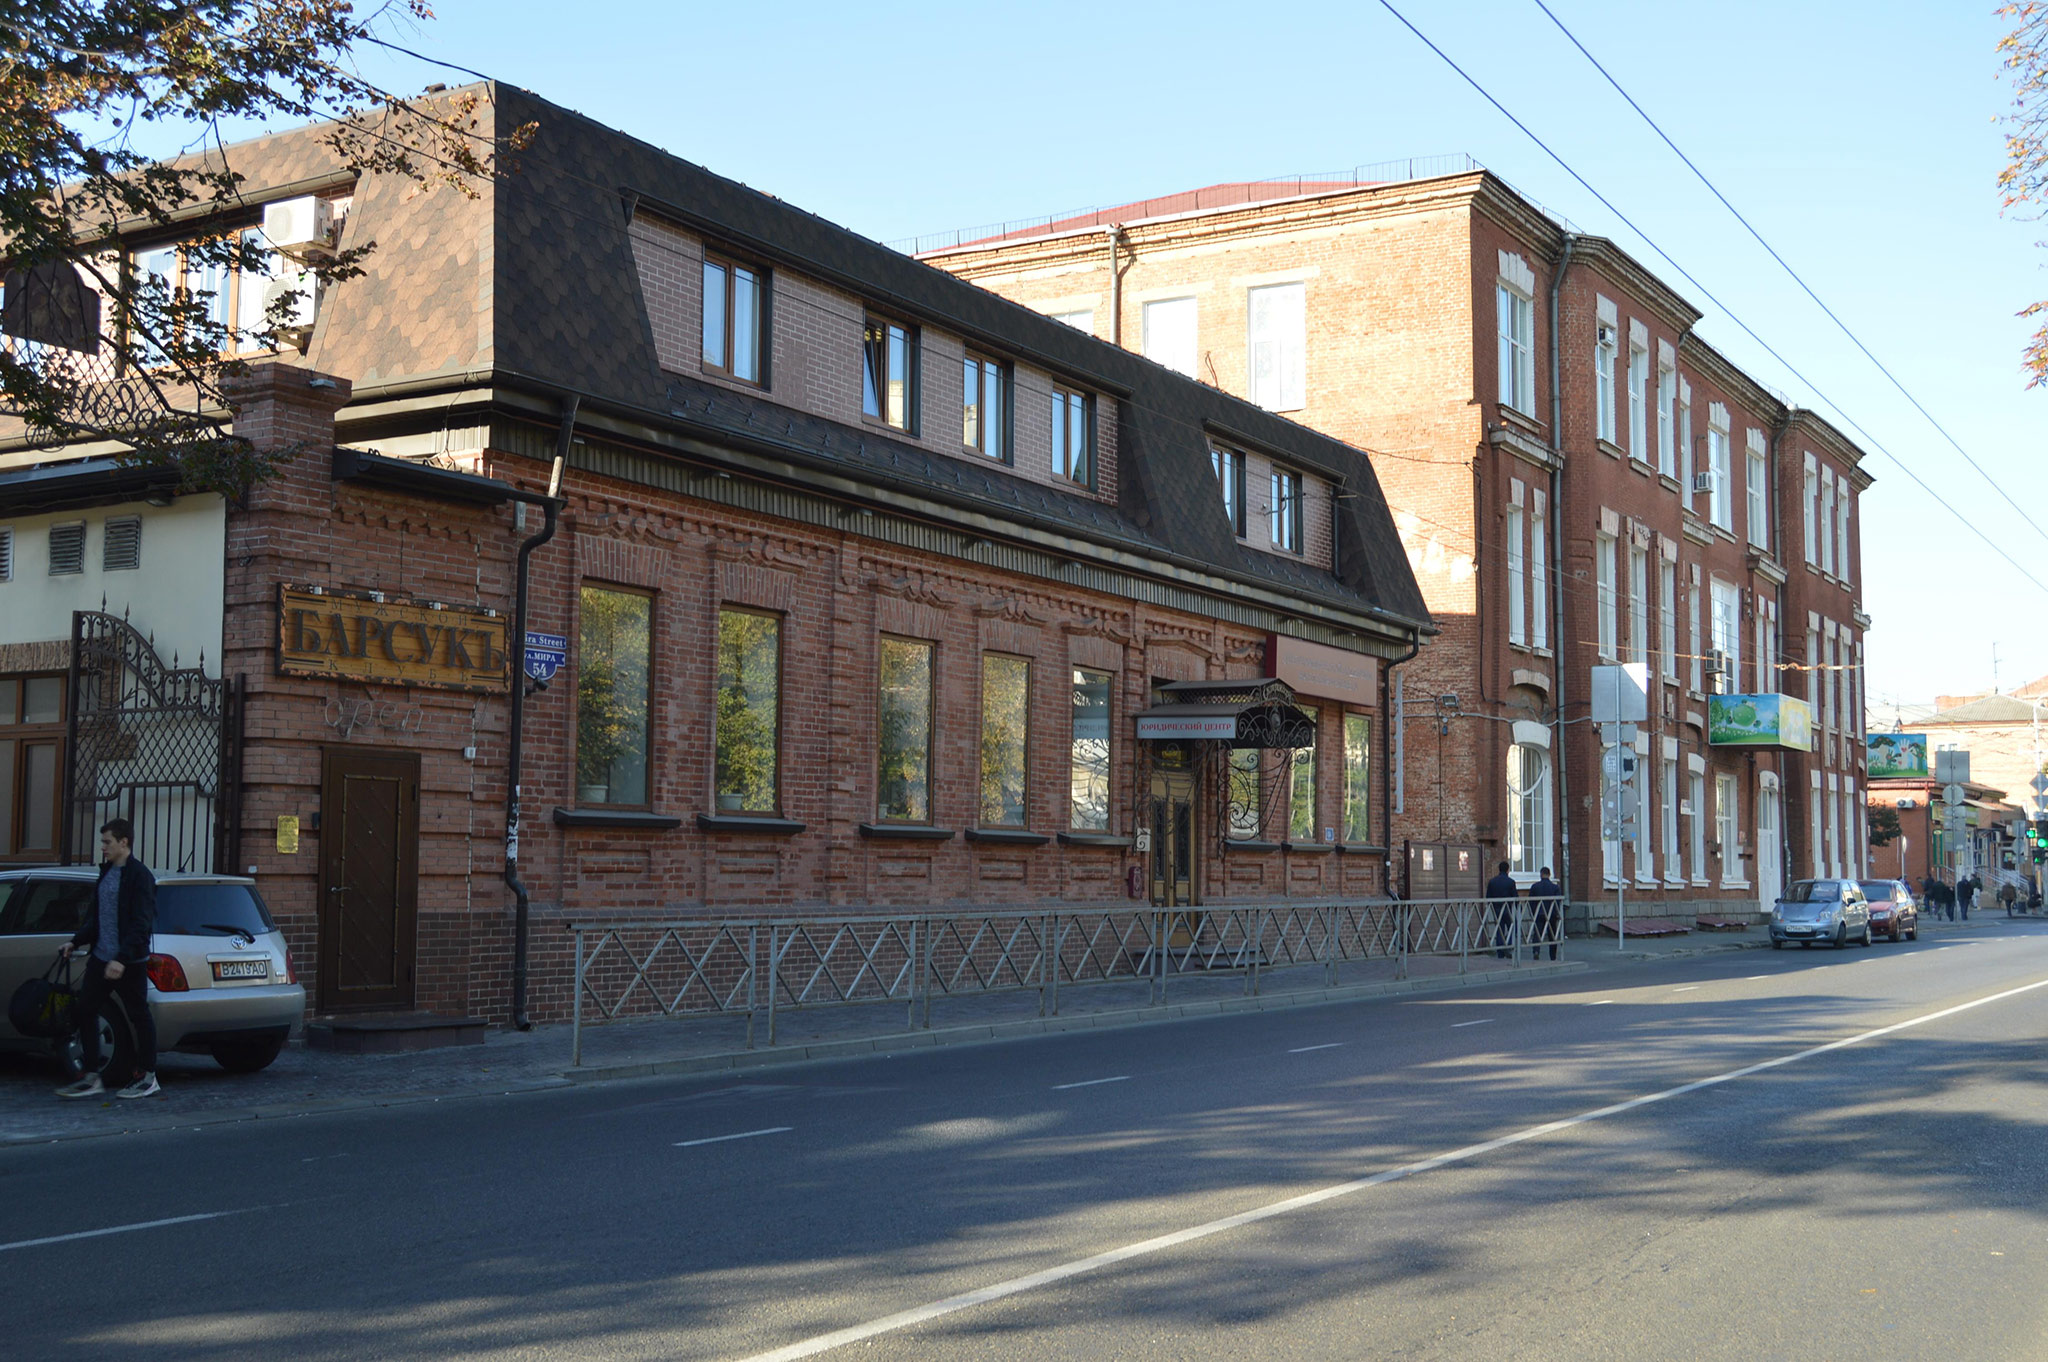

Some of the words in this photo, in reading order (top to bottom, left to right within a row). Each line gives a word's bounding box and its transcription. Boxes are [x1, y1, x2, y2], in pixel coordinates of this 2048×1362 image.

[292, 607, 506, 671] БАРСУКЪ
[525, 634, 537, 643] ira
[539, 636, 563, 647] Street
[532, 662, 547, 677] 54
[325, 697, 424, 740] open
[1140, 721, 1202, 732] ЮРИДИЧЕСКИЙ
[1204, 722, 1232, 732] ЦЕНТР
